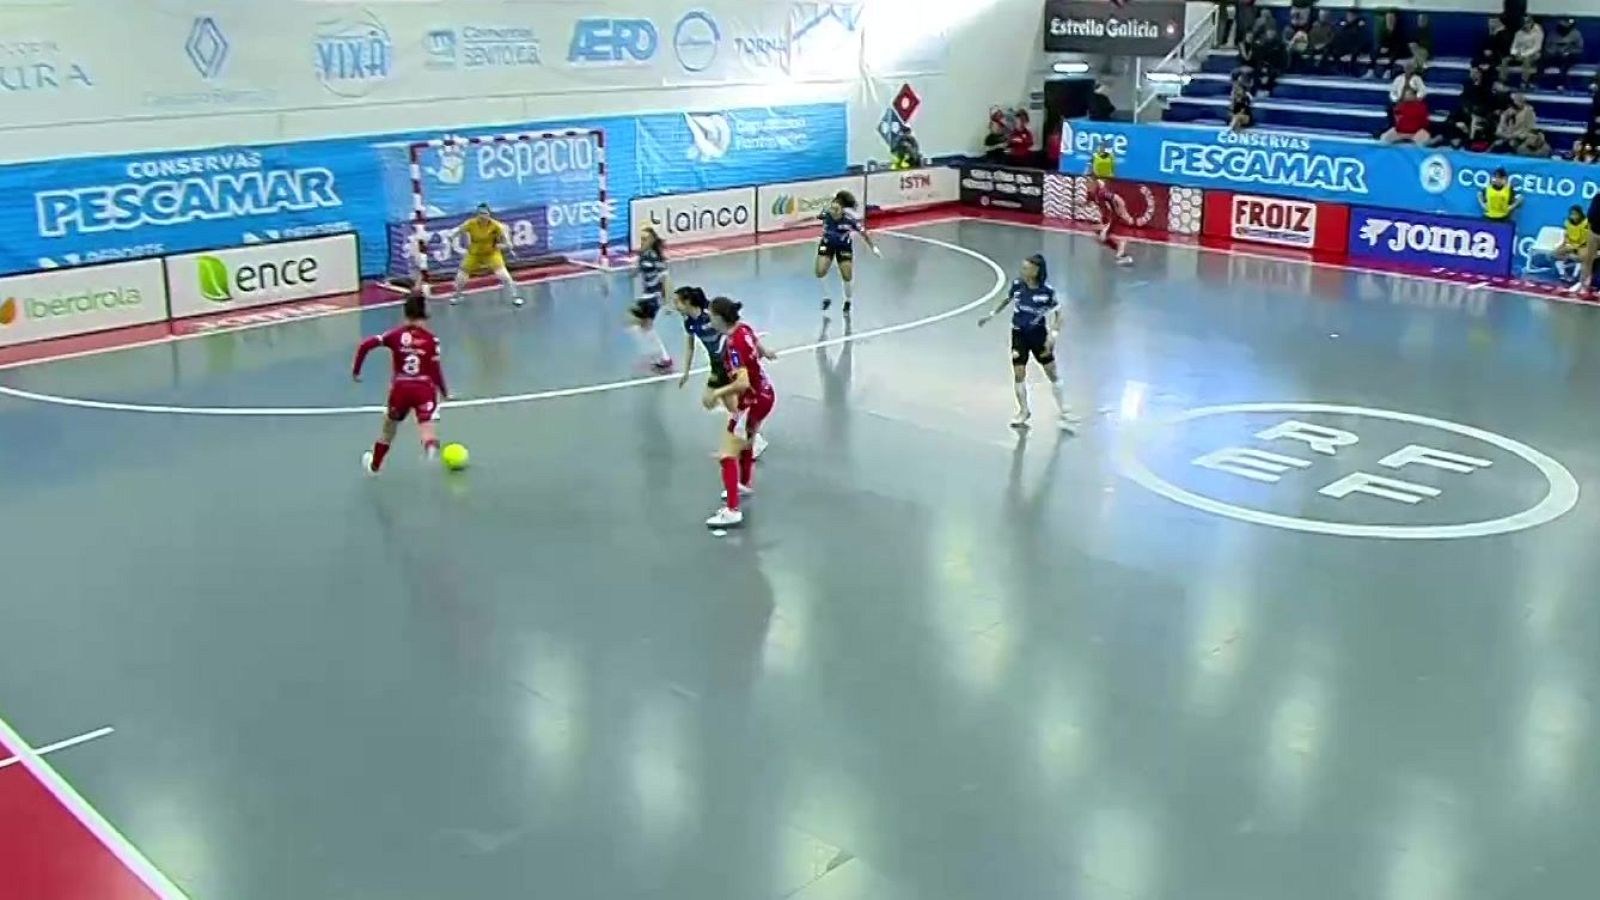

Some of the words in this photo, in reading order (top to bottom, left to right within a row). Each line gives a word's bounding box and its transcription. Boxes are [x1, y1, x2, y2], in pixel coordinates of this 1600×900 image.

[1050, 18, 1103, 36] Estrella
[1106, 19, 1158, 38] Galicia
[1217, 131, 1311, 151] CONSERVAS
[127, 152, 262, 179] CONSERVAS
[1160, 142, 1368, 193] PESCAMAR
[1458, 168, 1576, 197] COCELLO
[37, 168, 341, 237] PESCAMAR
[1235, 200, 1312, 231] FROIZ
[665, 204, 749, 233] lainco
[235, 256, 318, 292] ence
